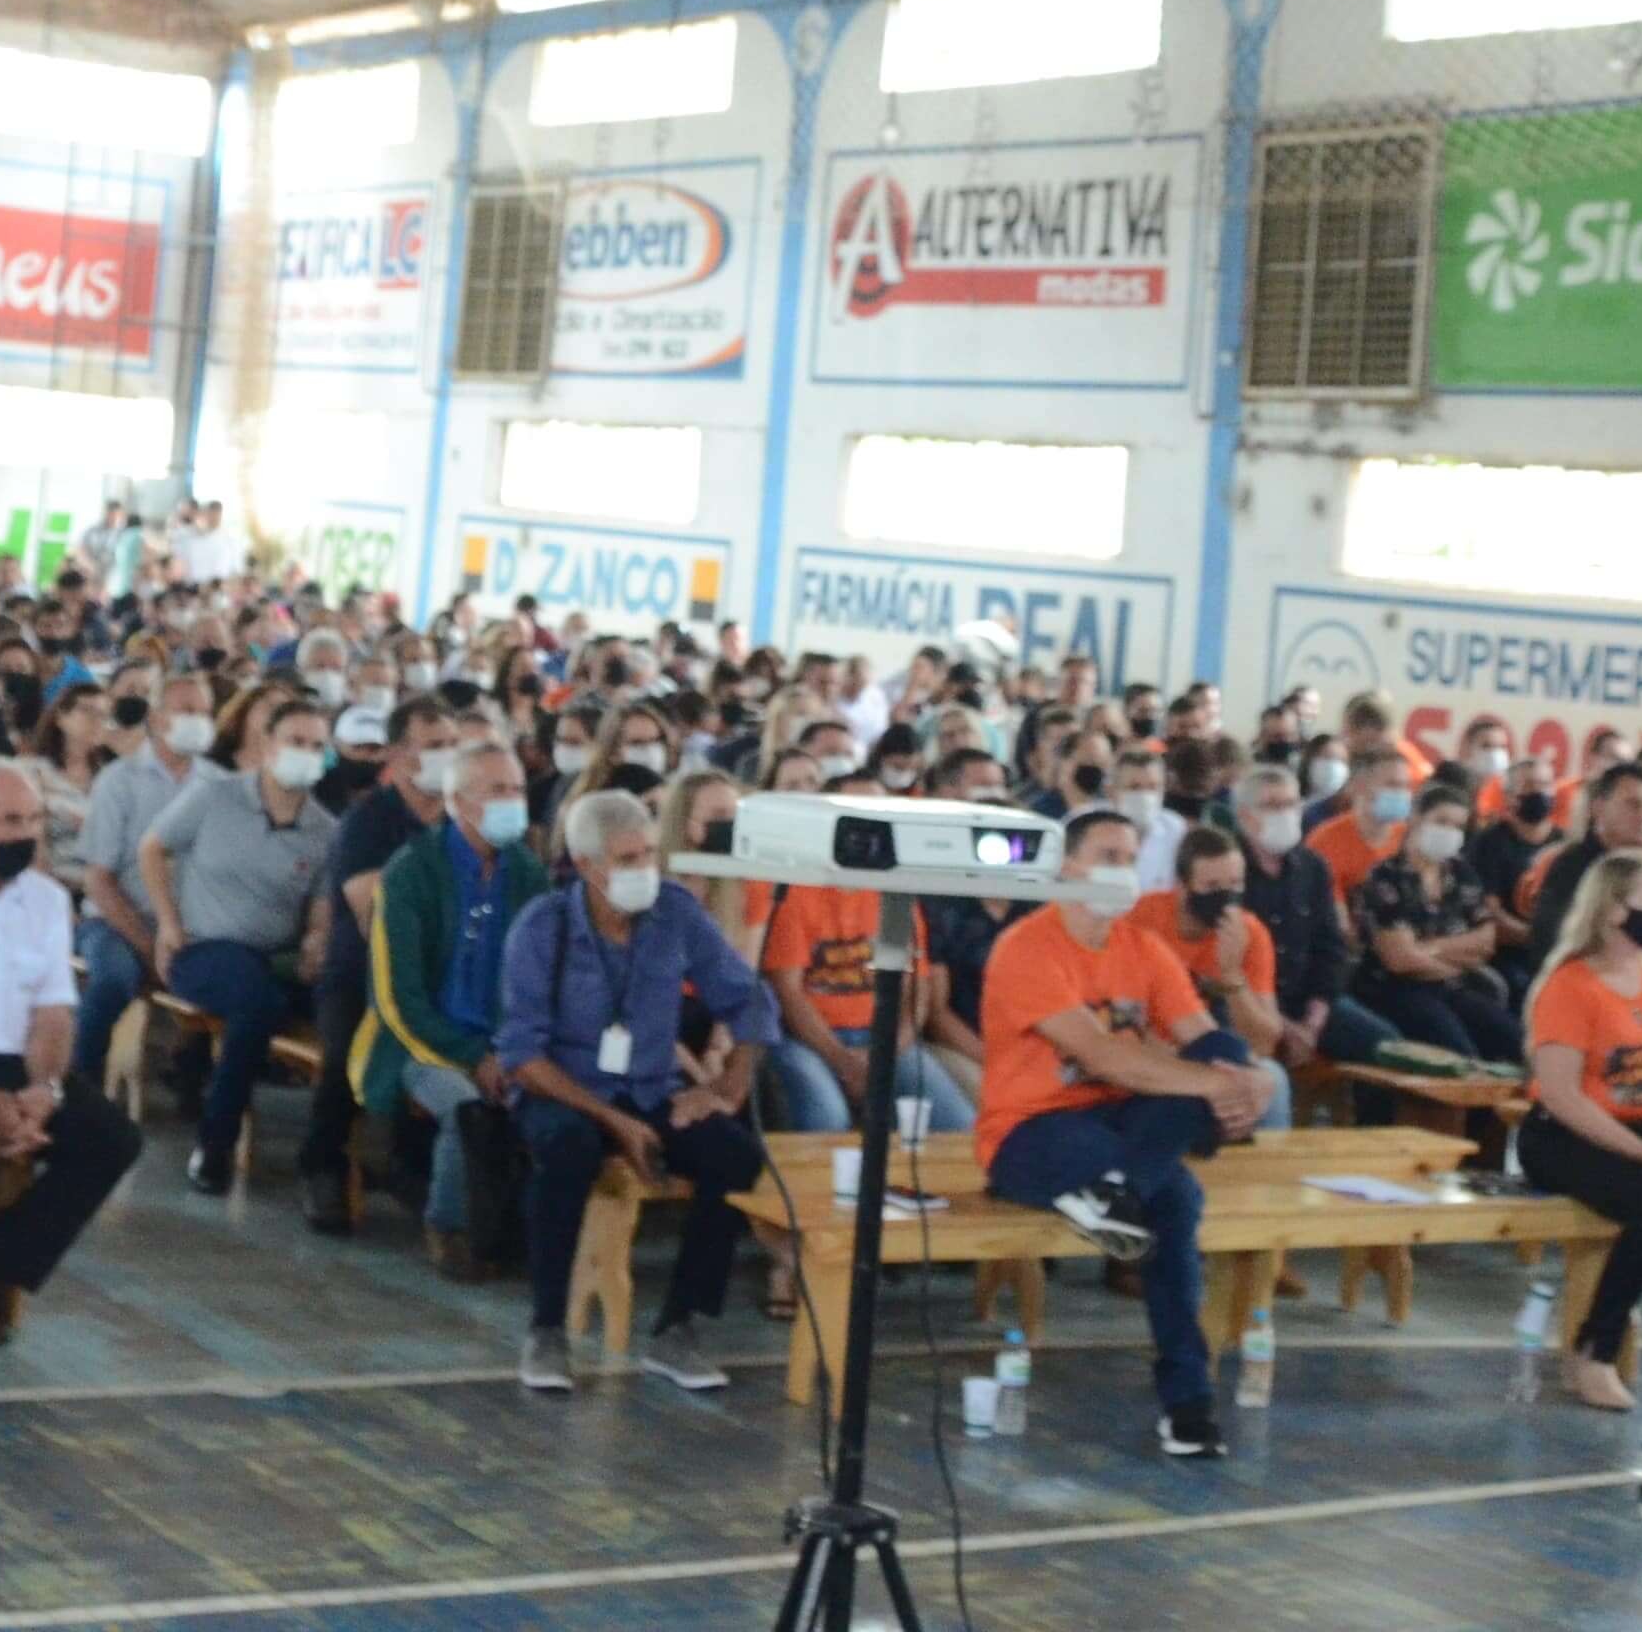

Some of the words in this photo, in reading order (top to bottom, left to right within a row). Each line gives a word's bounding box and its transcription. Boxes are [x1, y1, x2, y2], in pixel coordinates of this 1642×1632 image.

[564, 202, 688, 270] ebben
[913, 174, 1170, 261] ALTERNATIVA
[798, 567, 954, 636] FARMÁCIA
